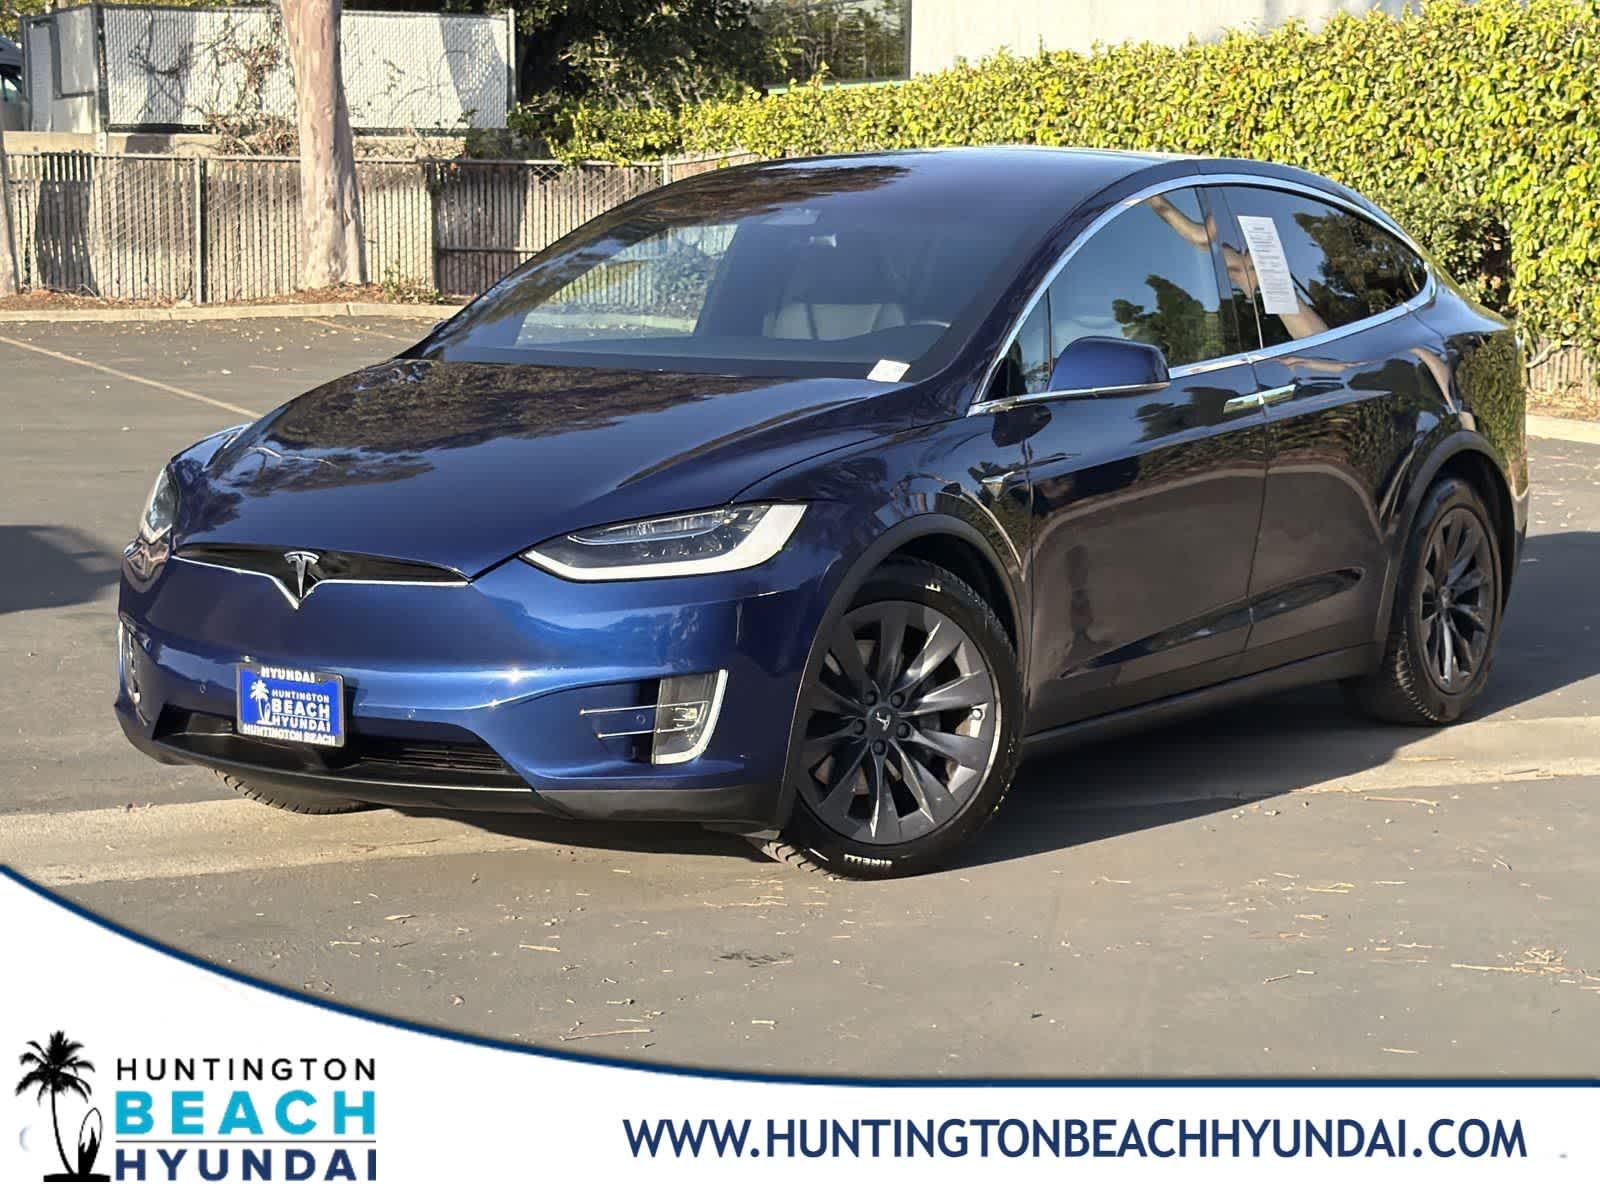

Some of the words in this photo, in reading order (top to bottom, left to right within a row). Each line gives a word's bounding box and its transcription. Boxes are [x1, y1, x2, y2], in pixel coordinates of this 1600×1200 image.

[261, 667, 315, 684] HYUNDAI
[272, 689, 330, 703] HUNTINGTON
[271, 699, 330, 719] BEACH
[272, 715, 331, 732] HYUNDAI
[243, 724, 303, 742] HUNTINGTON
[304, 732, 336, 746] BEACH
